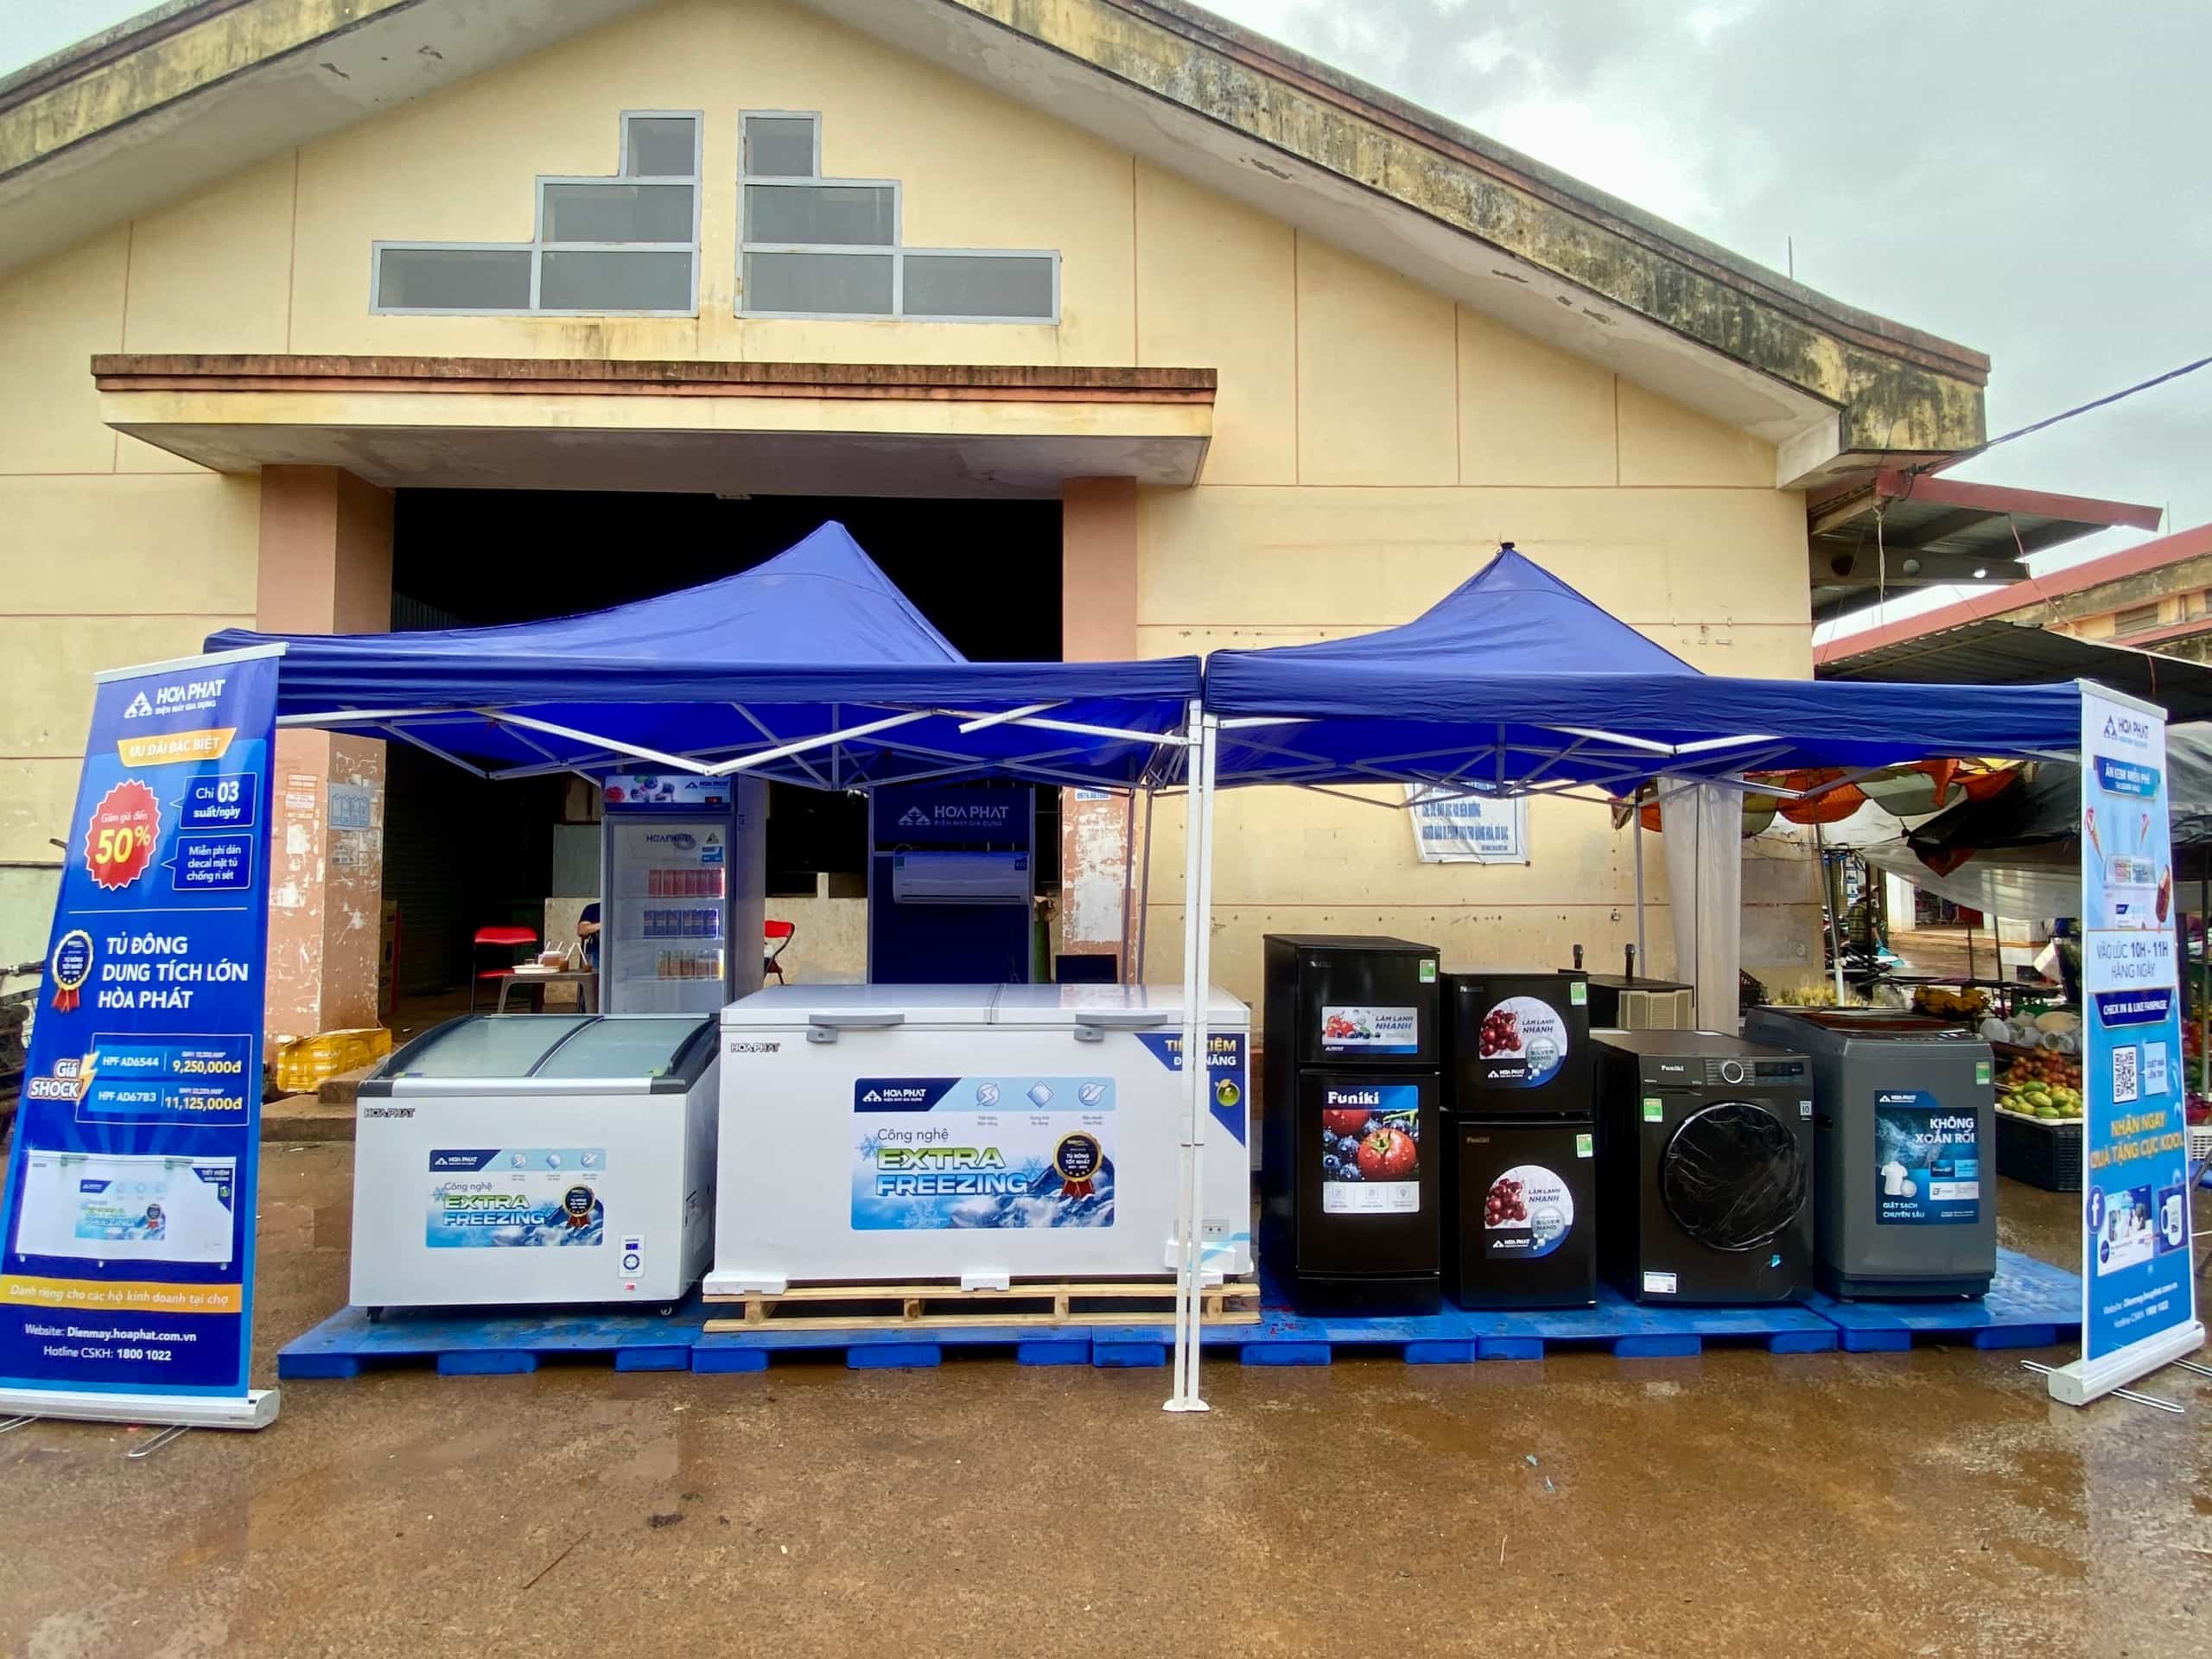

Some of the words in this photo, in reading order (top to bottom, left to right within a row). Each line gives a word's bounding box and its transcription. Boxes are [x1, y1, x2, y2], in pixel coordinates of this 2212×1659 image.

[194, 735, 220, 753] BIỆT
[218, 780, 239, 803] 03
[194, 805, 240, 820] suất/ngày
[95, 824, 151, 864] 50%
[188, 857, 212, 868] decal
[187, 870, 213, 882] chống
[106, 931, 128, 955] TỦ
[131, 932, 188, 955] ĐÔNG
[2153, 941, 2168, 957] 11H
[102, 963, 150, 982] DUNG
[156, 959, 202, 982] TÍCH
[207, 958, 249, 982] LỚN
[98, 986, 135, 1009] HÒA
[139, 987, 194, 1009] PHÁT
[55, 1059, 79, 1077] Giá
[120, 1057, 160, 1067] AD6544
[30, 1081, 79, 1097] SHOCK
[1327, 1091, 1380, 1104] Funiki
[1929, 1116, 1974, 1128] KHÔNG
[877, 1127, 912, 1144] Công
[917, 1126, 949, 1144] nghệ
[1955, 1129, 1975, 1143] RỐI
[876, 1147, 1006, 1170] EXTRA
[444, 1181, 467, 1193] Công
[470, 1181, 493, 1192] nghệ
[875, 1173, 1028, 1197] FREEZING
[443, 1195, 530, 1210] EXTRA
[443, 1211, 546, 1226] FREEZING
[67, 1288, 85, 1300] cho
[108, 1290, 123, 1302] hộ
[127, 1291, 149, 1302] kinh
[153, 1292, 186, 1304] doanh
[189, 1293, 204, 1306] tại
[207, 1293, 229, 1306] chợ
[25, 1323, 65, 1337] Website:
[67, 1325, 196, 1342] Dienmay.hoaphat.com.vn
[43, 1345, 79, 1357] Hotline
[81, 1347, 113, 1359] CSKH:
[117, 1349, 143, 1359] 1800
[146, 1350, 171, 1360] 1022
